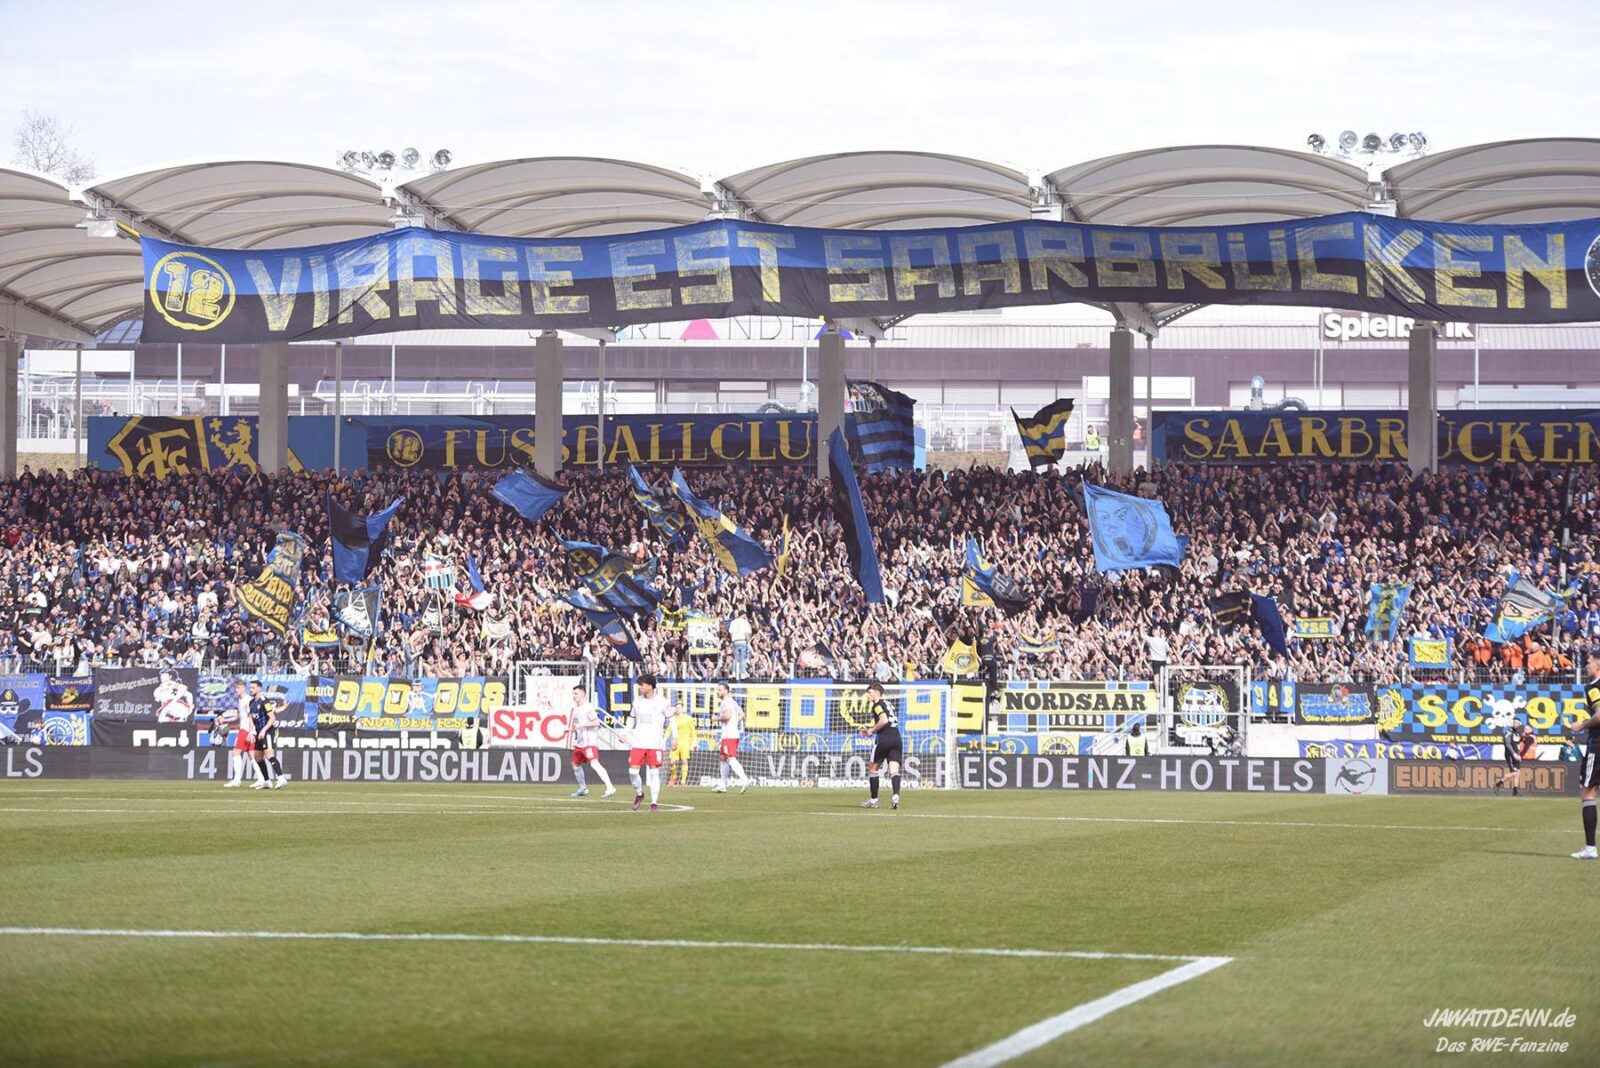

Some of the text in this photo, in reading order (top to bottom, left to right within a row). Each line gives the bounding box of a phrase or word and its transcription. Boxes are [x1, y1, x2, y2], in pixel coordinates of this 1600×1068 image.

[164, 222, 1568, 331] 12 VIRAGE EST SAARBRÜCKEN
[1005, 692, 1148, 711] NORDSAAR
[1416, 695, 1484, 728] SC
[492, 709, 568, 742] SFC
[1051, 714, 1103, 726] JUGEND
[7, 748, 43, 777] LS
[183, 750, 218, 779] 14
[302, 750, 331, 780] IN
[343, 750, 561, 782] DEUTSCHLAND
